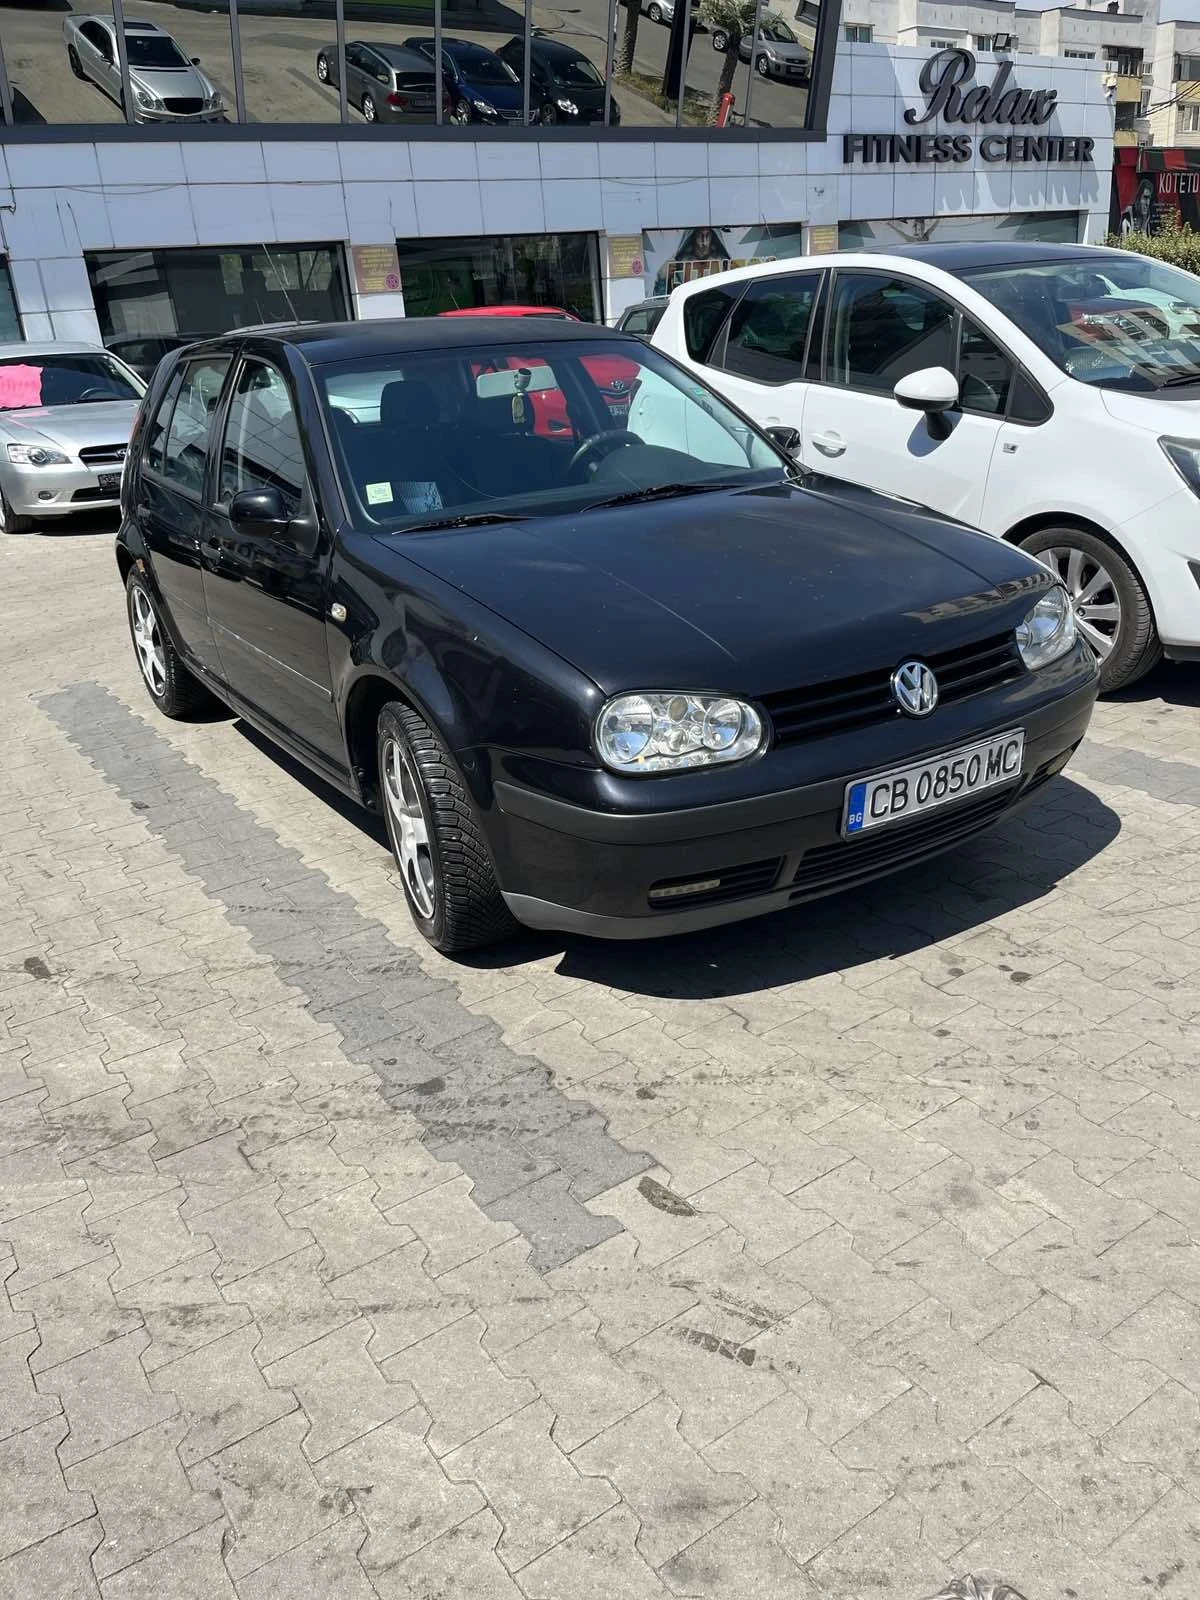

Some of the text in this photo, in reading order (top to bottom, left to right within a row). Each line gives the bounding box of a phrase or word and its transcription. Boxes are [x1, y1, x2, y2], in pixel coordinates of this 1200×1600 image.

[904, 48, 1057, 126] Relax
[843, 134, 1095, 163] FITNESS CENTER
[870, 740, 1019, 818] CB 0850 MC
[849, 812, 862, 825] BG
